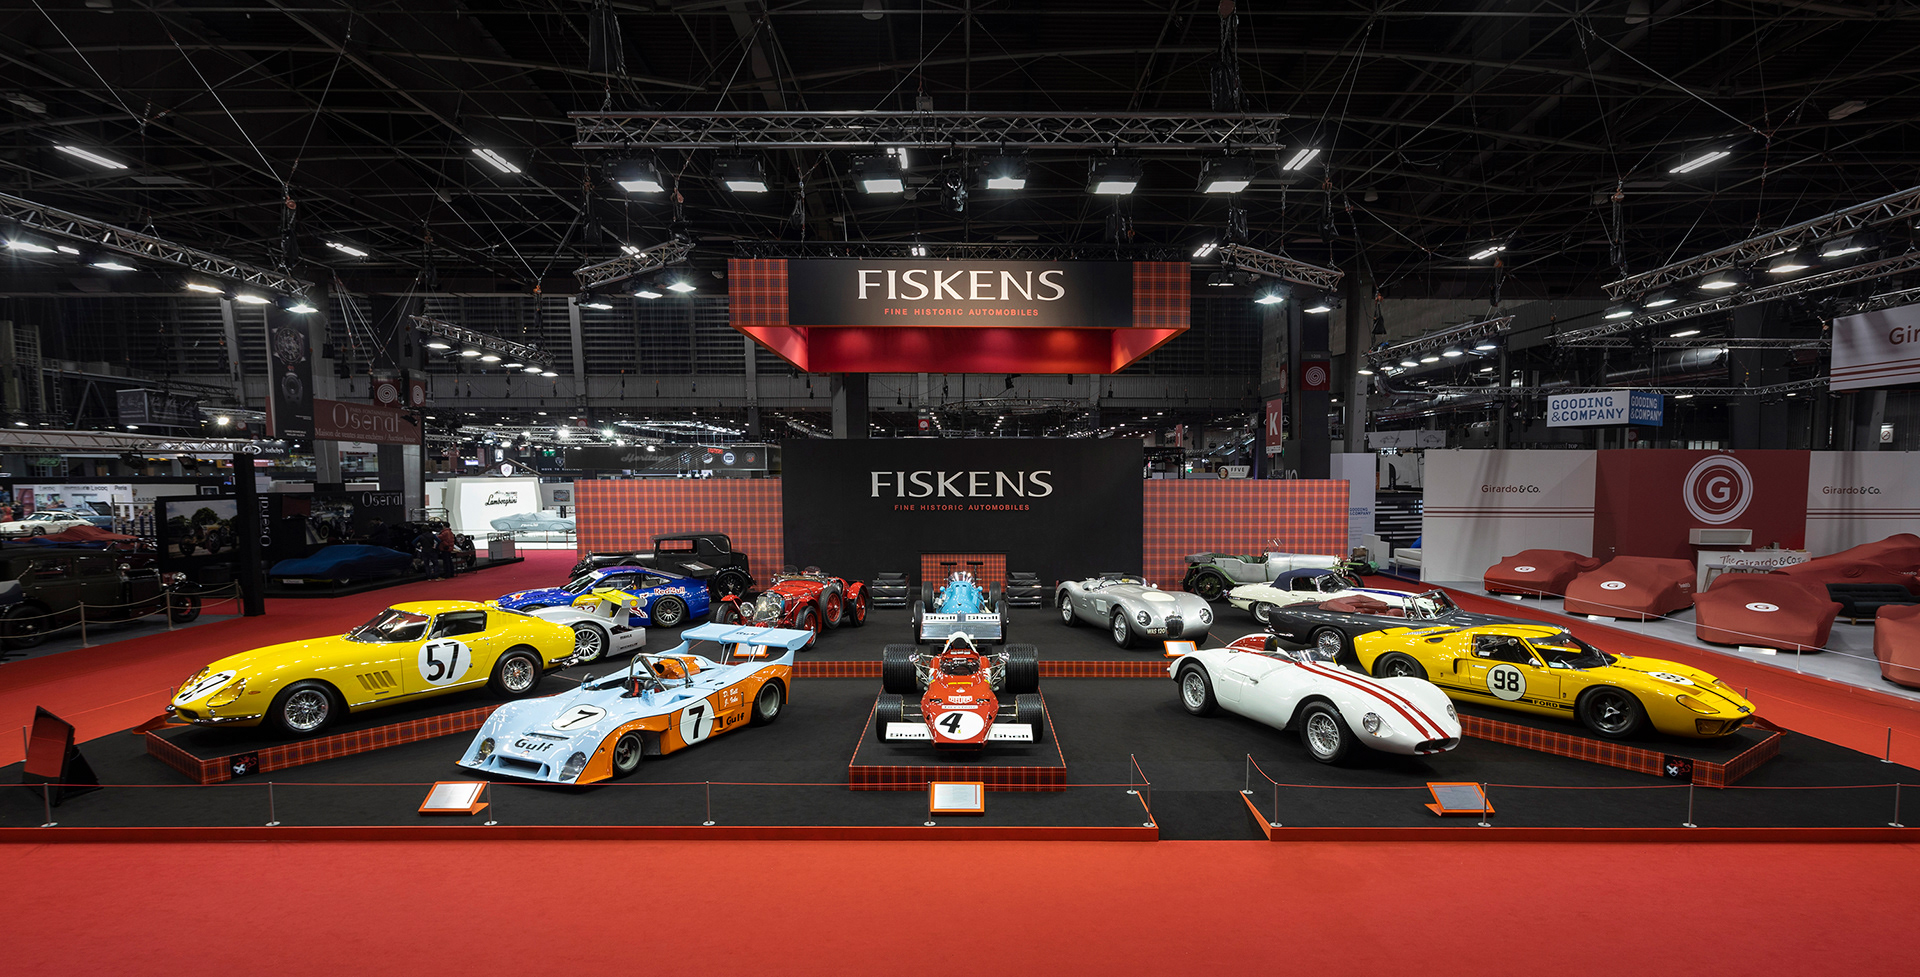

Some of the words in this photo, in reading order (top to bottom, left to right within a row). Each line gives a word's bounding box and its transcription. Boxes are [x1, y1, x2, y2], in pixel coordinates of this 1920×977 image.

[857, 269, 1065, 301] FISKENS
[914, 308, 964, 316] HISTORIC
[968, 308, 1039, 316] AUTOMOBILES
[1551, 396, 1613, 410] GOODING
[1630, 396, 1658, 409] GOODING
[1269, 411, 1278, 436] K
[870, 470, 1053, 498] FISKENS
[1705, 476, 1731, 503] G
[1720, 554, 1735, 565] The
[426, 641, 460, 682] 57
[1494, 670, 1520, 692] 98
[1533, 699, 1559, 708] FORD
[560, 709, 599, 728] 7
[688, 704, 705, 740] 7
[726, 712, 745, 725] Gulf
[939, 712, 964, 734] 4
[514, 738, 554, 752] Gulf
